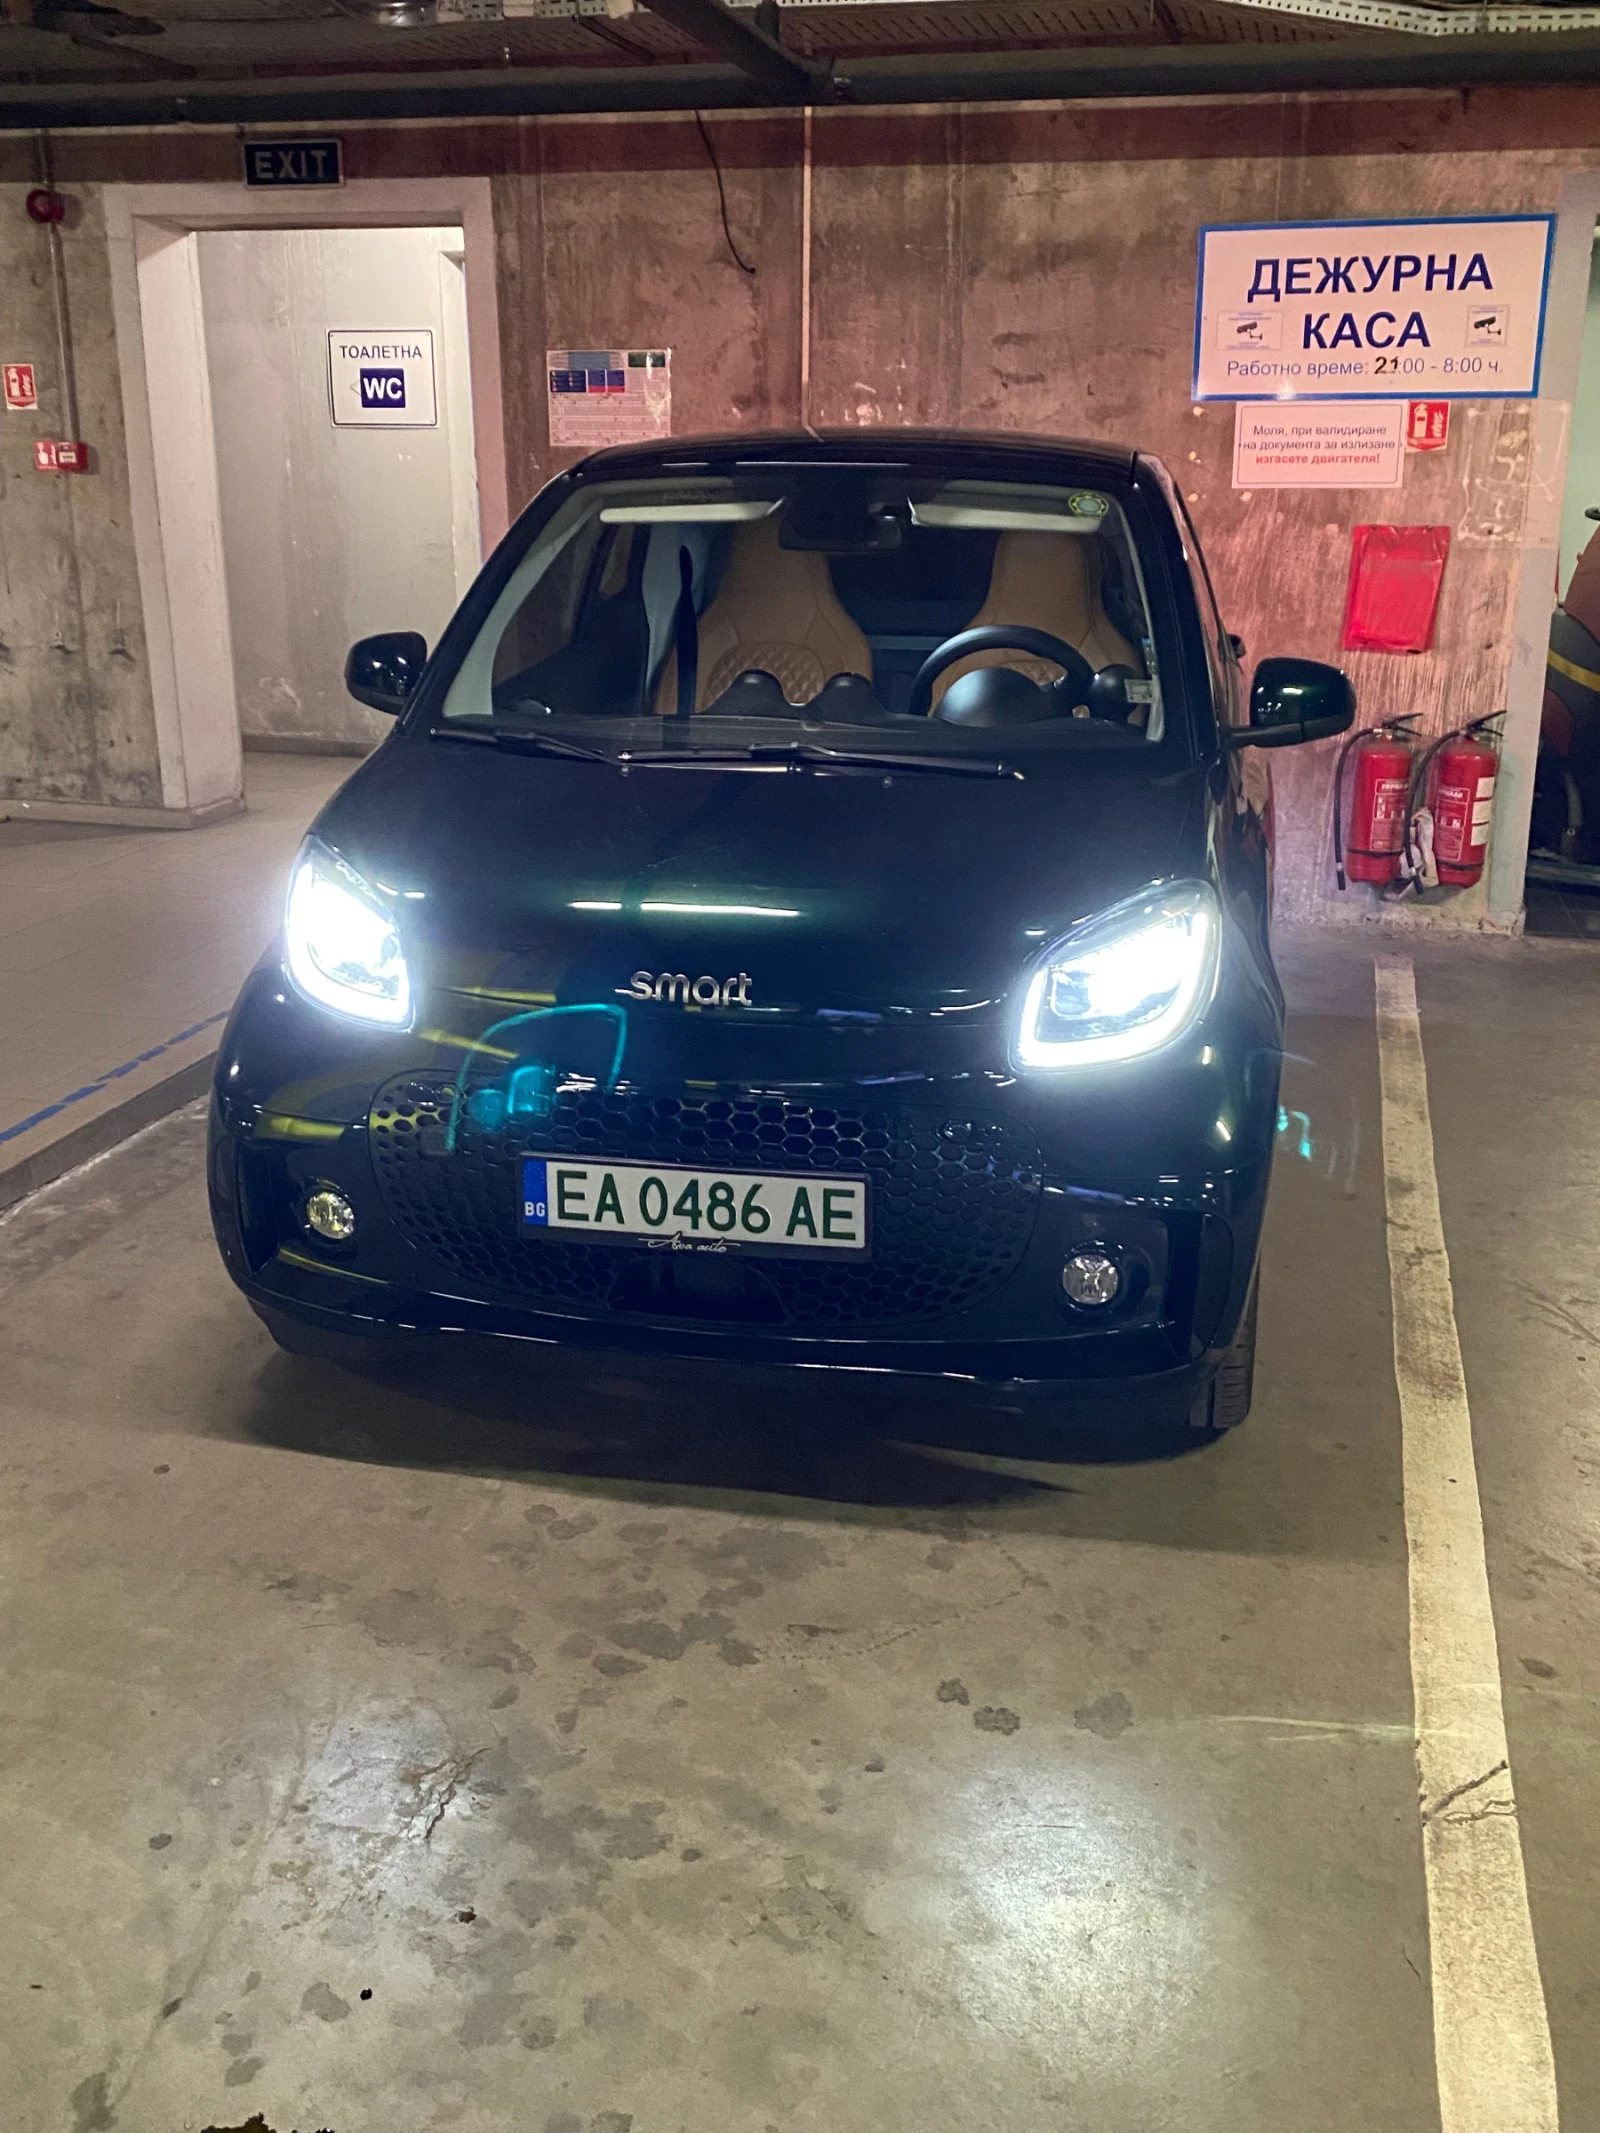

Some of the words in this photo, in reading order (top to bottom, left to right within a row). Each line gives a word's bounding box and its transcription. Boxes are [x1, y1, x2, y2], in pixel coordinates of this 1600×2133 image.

[254, 150, 328, 178] EXIT
[1247, 253, 1493, 303] ДЕЖУРНА
[1303, 311, 1431, 349] КАСА
[339, 345, 422, 359] ТОАЛЕТНА
[1227, 360, 1301, 377] Работно
[1307, 362, 1369, 379] време:
[1443, 357, 1482, 373] 8:00
[363, 378, 402, 399] WC
[1253, 425, 1288, 436] Моля,
[1291, 427, 1312, 437] при
[1315, 426, 1386, 437] валидиране
[1243, 442, 1257, 450] на
[1259, 440, 1321, 453] документа
[1324, 441, 1338, 450] за
[1341, 440, 1396, 450] излизане
[1255, 454, 1308, 464] изгасете
[1311, 453, 1381, 465] двигателя!
[630, 971, 753, 1006] smart
[524, 1201, 546, 1218] BG
[556, 1169, 625, 1225] EA
[638, 1176, 771, 1234] 0486
[785, 1186, 857, 1241] AE
